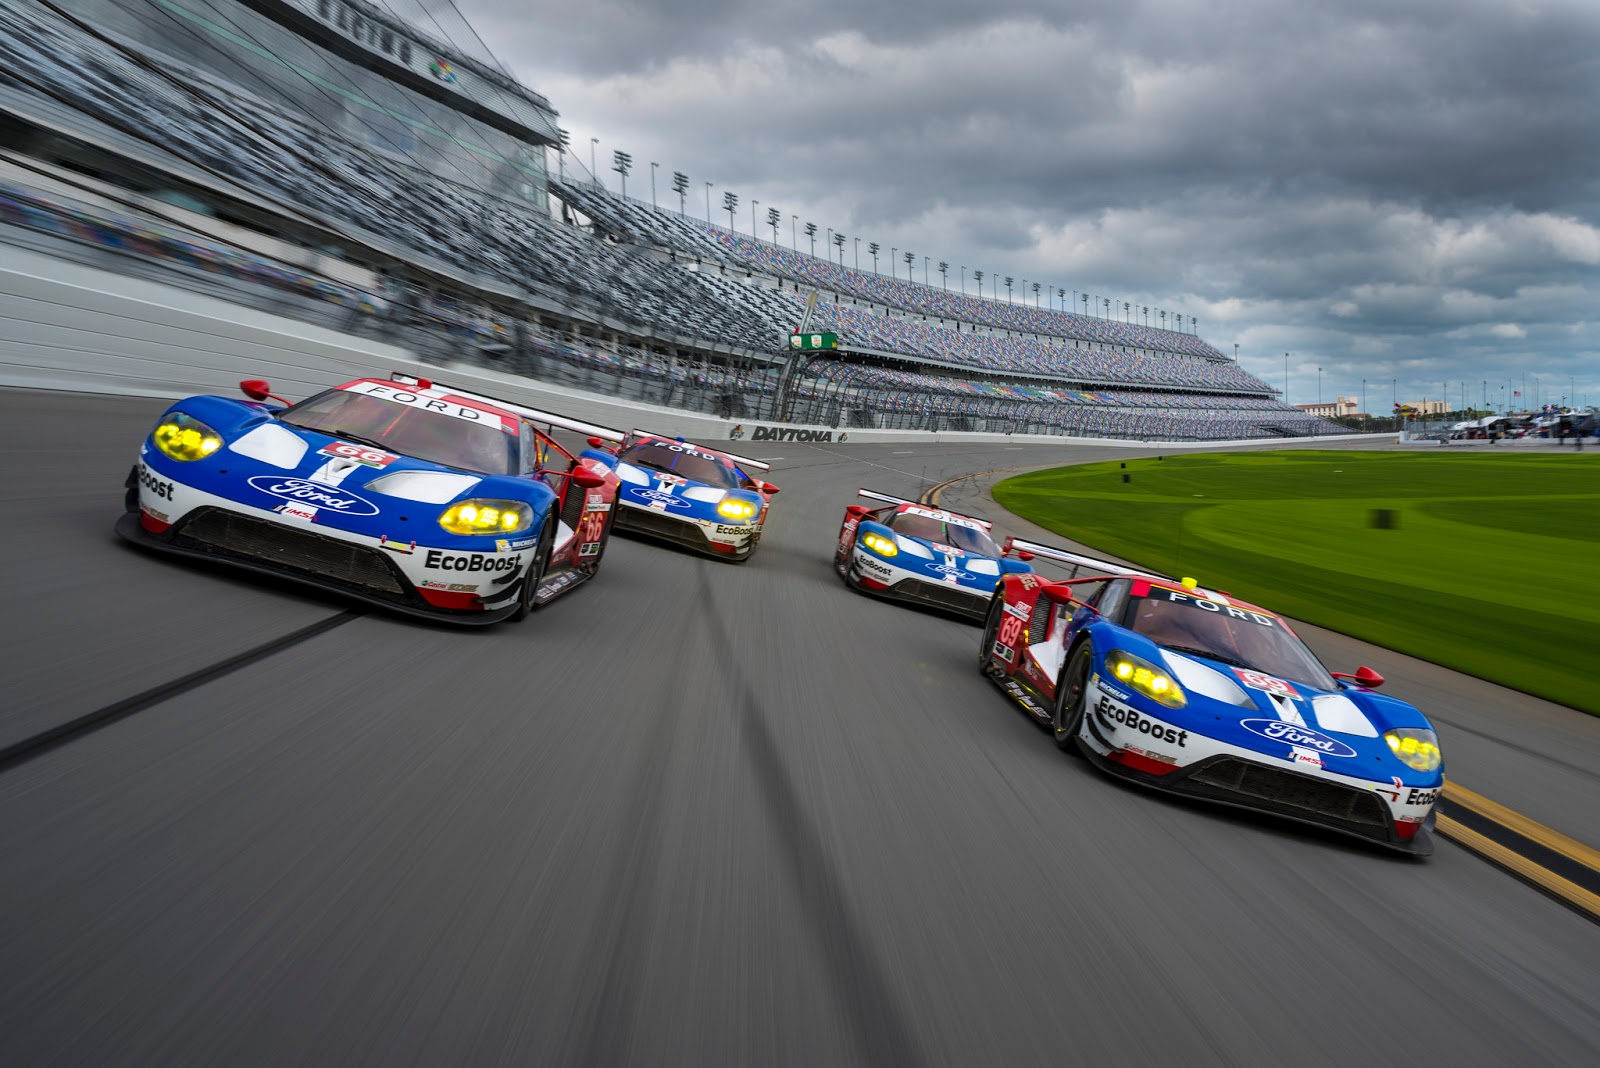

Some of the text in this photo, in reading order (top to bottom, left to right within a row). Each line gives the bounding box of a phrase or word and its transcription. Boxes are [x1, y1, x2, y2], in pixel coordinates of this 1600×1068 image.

[367, 386, 480, 420] FORD
[751, 426, 832, 442] DAYTONA
[335, 445, 386, 462] 66
[654, 442, 715, 460] FORD
[140, 463, 174, 502] Boost
[270, 480, 357, 509] Ford
[586, 512, 604, 542] 66
[425, 549, 522, 572] EcoBoost
[860, 554, 893, 576] EcoBoost
[1168, 592, 1273, 627] FORD
[1001, 616, 1022, 647] 69
[1243, 671, 1289, 693] 69
[1100, 695, 1188, 748] EcoBoost
[1264, 722, 1336, 752] Ford
